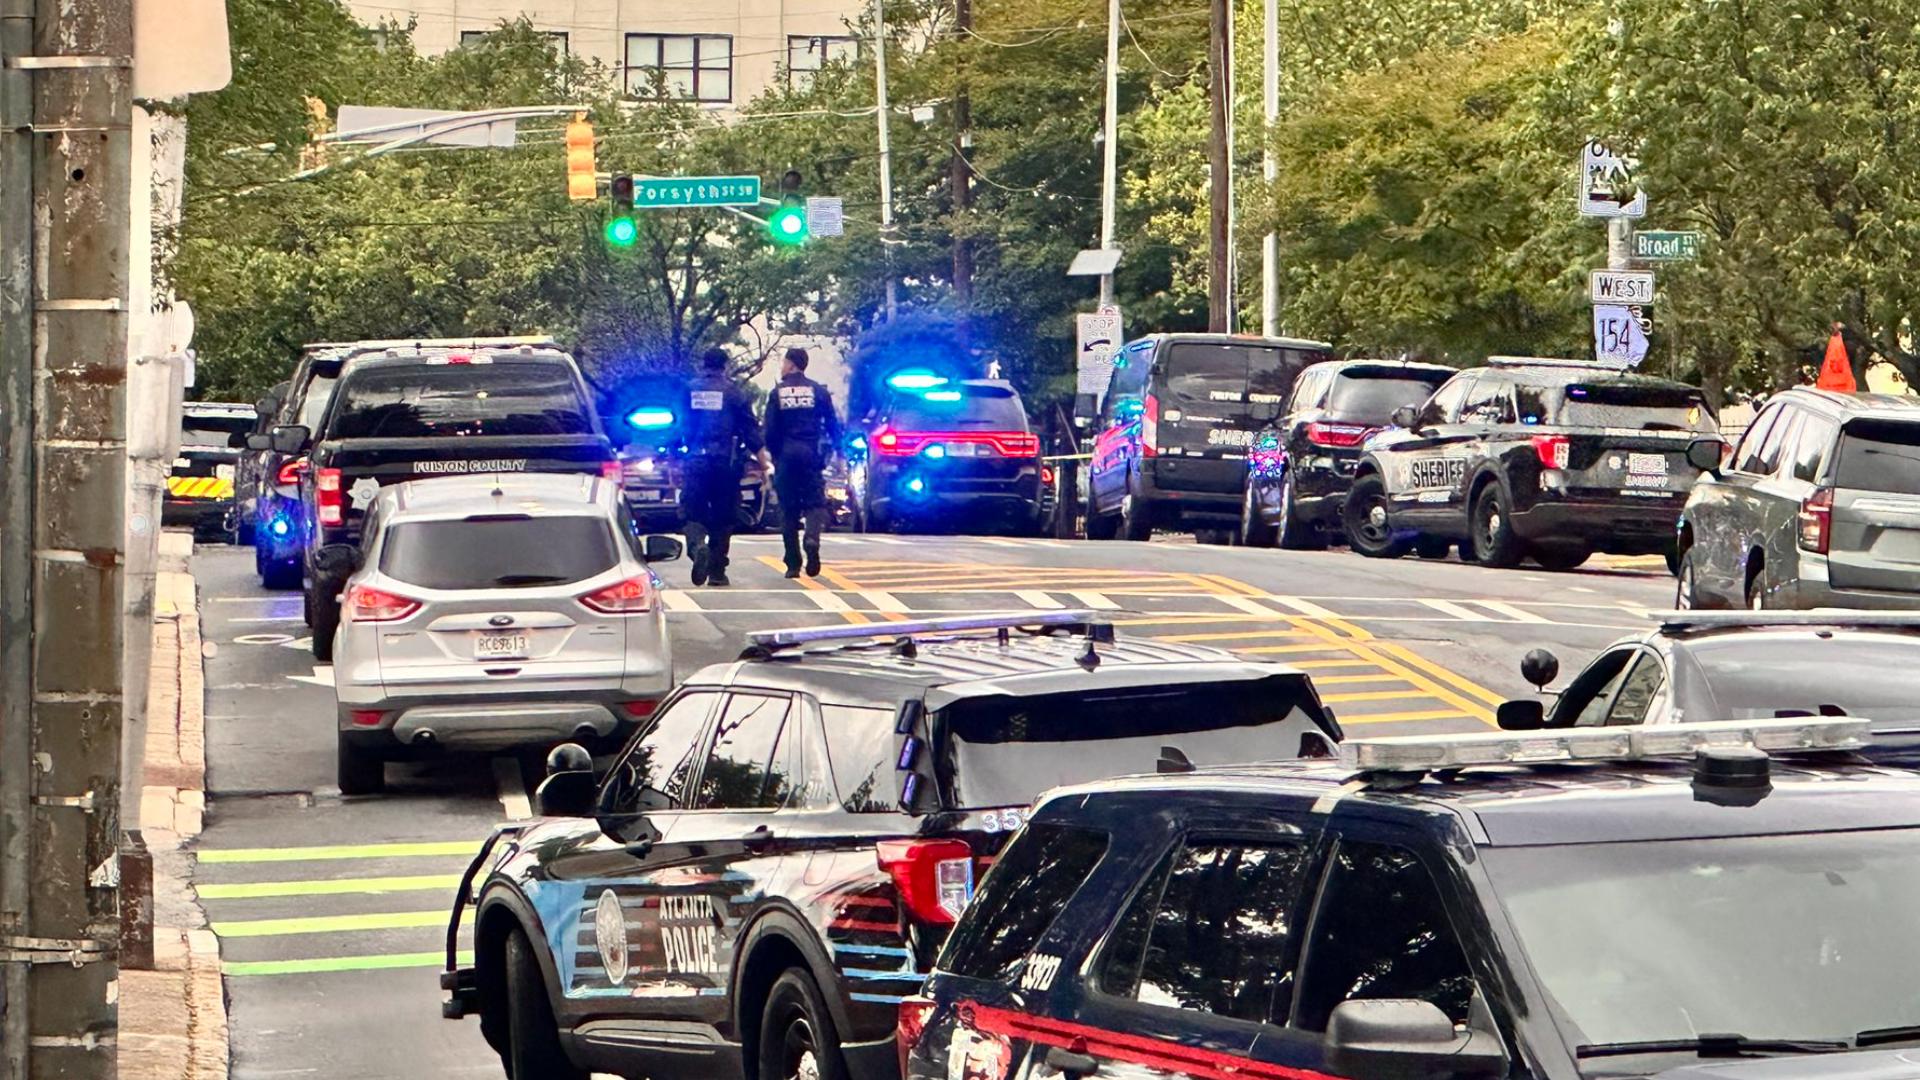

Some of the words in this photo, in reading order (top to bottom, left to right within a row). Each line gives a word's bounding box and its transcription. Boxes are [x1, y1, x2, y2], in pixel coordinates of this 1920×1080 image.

[634, 184, 719, 203] Forsyth
[1638, 235, 1679, 256] Broad
[1600, 277, 1647, 297] WEST
[1599, 318, 1630, 353] 154
[1208, 429, 1256, 446] SHER
[413, 461, 468, 474] FULTON
[468, 459, 527, 472] COUNTY
[1412, 460, 1464, 488] SHERIFF
[982, 808, 1029, 833] 35
[660, 895, 714, 920] ATLANTA
[661, 925, 718, 974] POLICE
